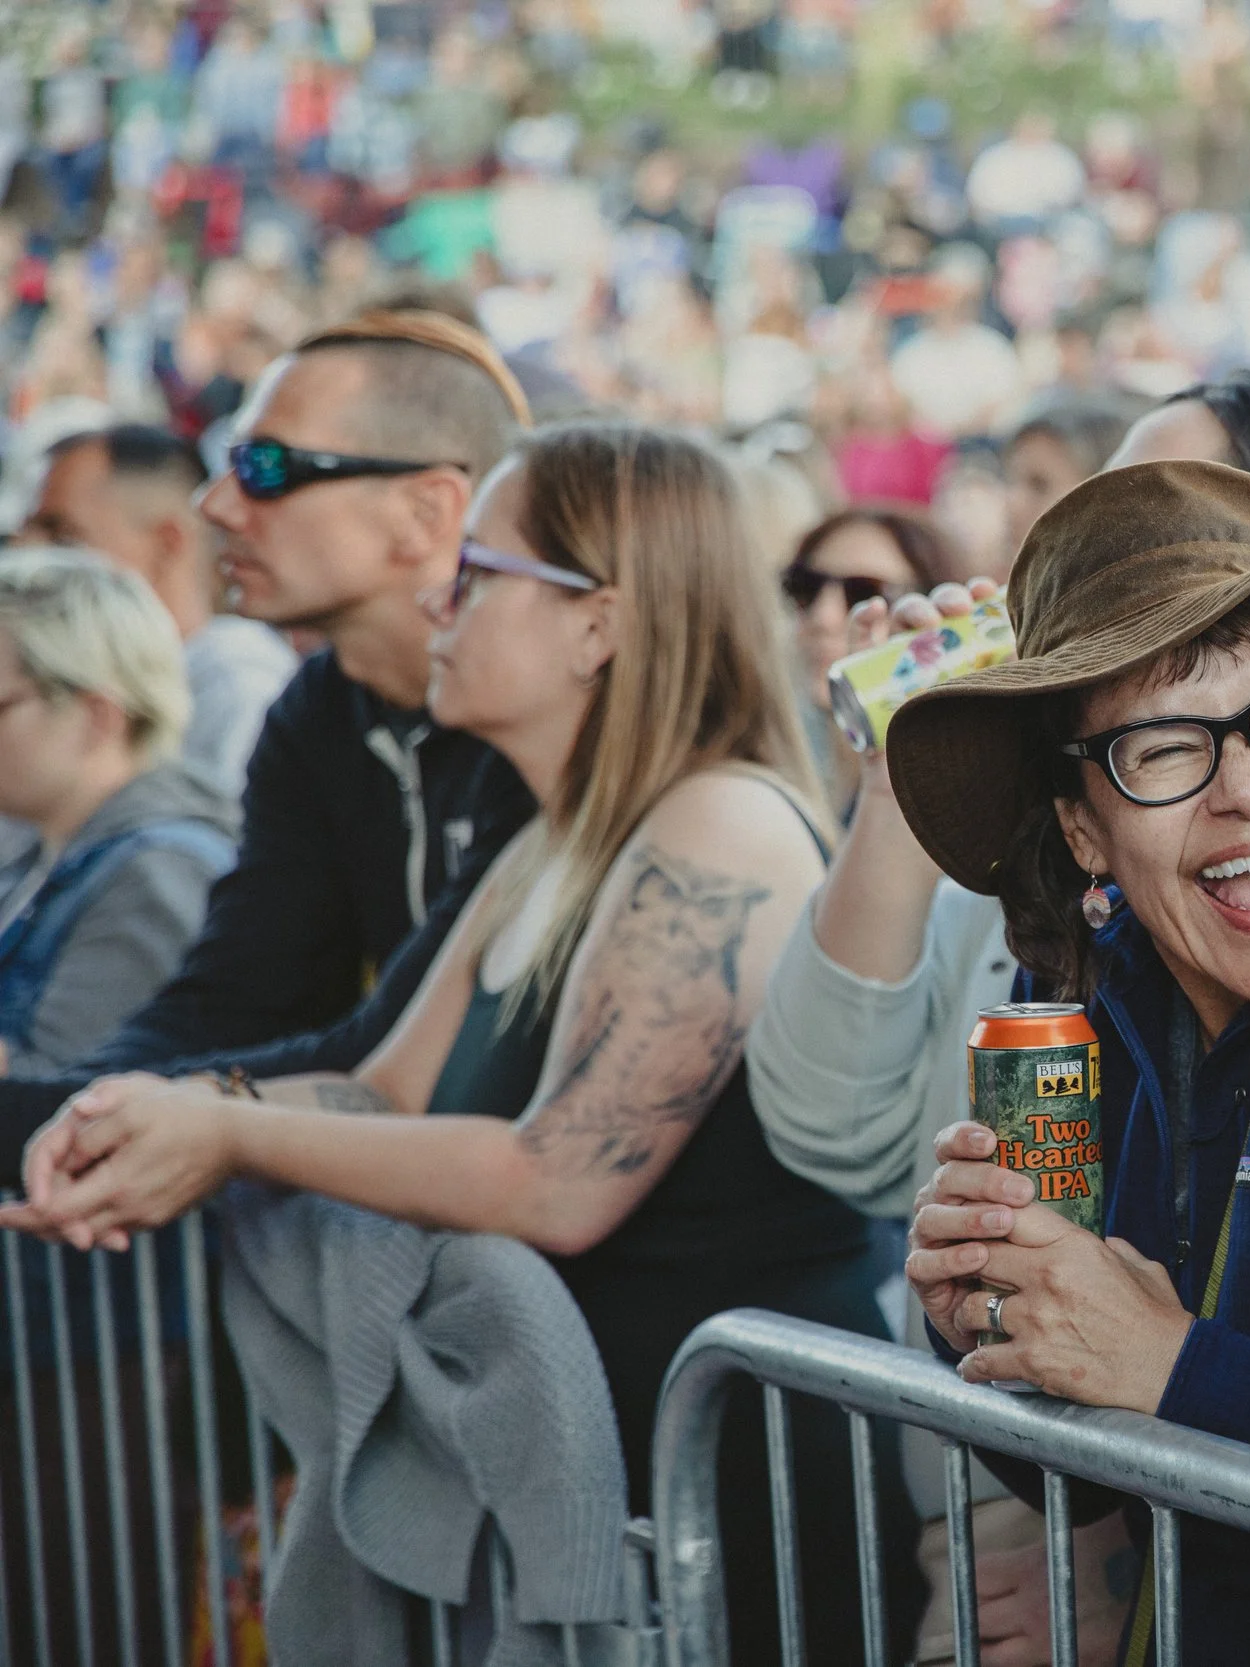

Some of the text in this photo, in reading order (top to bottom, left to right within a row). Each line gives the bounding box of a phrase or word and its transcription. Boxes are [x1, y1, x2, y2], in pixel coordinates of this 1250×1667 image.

[1040, 1061, 1082, 1077] BELL'S
[1027, 1114, 1091, 1144] Two
[1038, 1168, 1091, 1200] IPA
